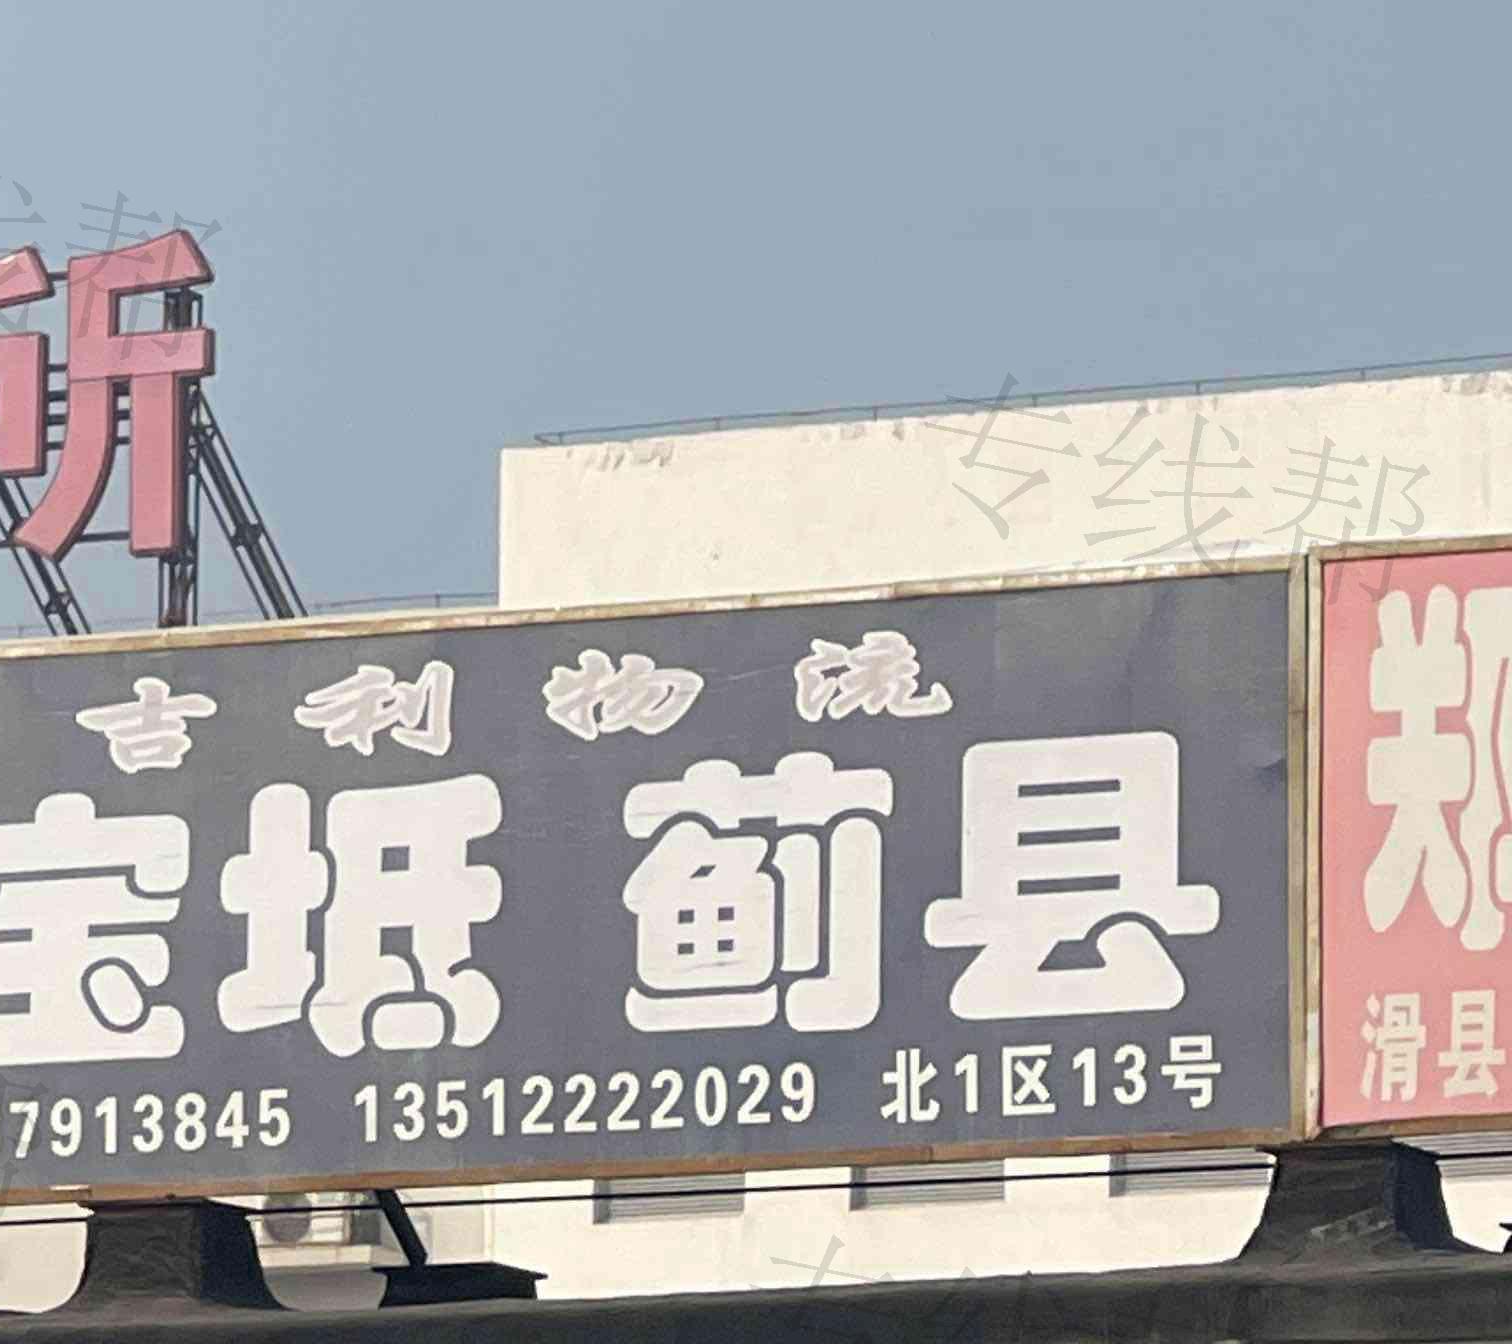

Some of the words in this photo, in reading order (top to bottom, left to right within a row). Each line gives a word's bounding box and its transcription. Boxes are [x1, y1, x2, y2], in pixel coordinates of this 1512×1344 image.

[624, 729, 1220, 1033] 蓟县
[355, 1063, 816, 1143] 13512222029
[881, 1035, 1222, 1125] 北1区13号
[1359, 989, 1507, 1102] 滑县
